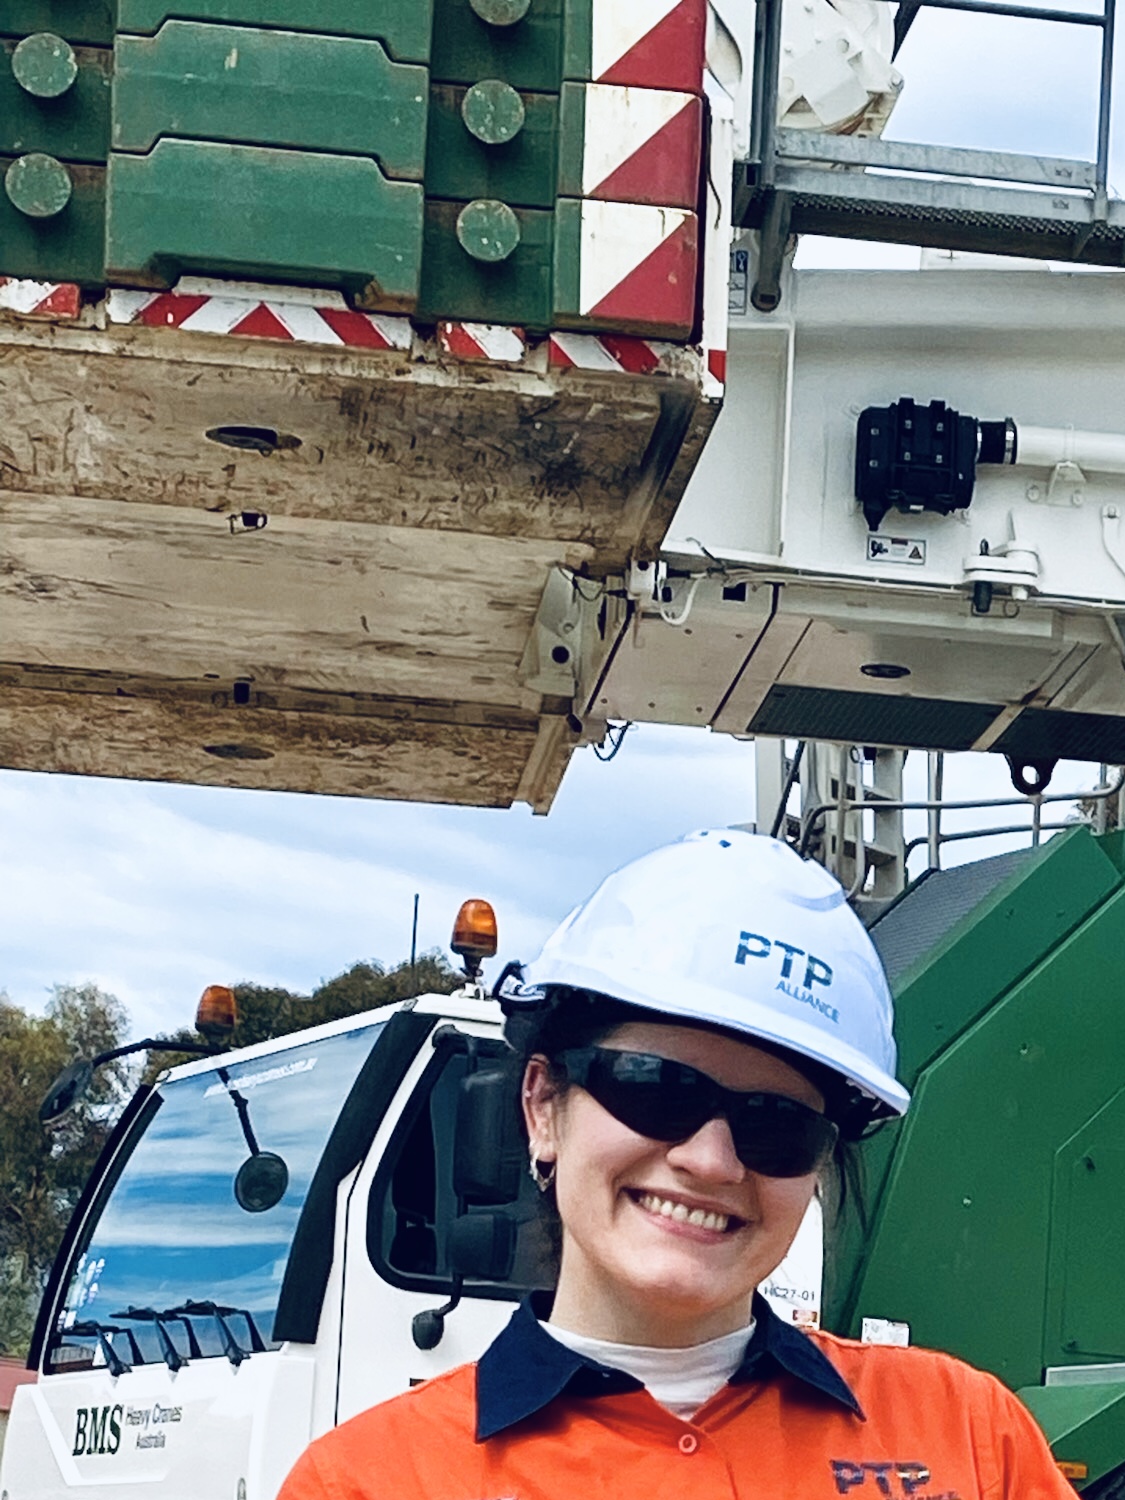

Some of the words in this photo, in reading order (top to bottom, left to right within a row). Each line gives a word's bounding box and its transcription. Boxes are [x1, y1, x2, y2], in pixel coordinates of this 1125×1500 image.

[735, 930, 834, 991] PTP
[774, 980, 840, 1024] ALLIANCE
[72, 1403, 124, 1457] BMS
[829, 1459, 931, 1495] PTP
